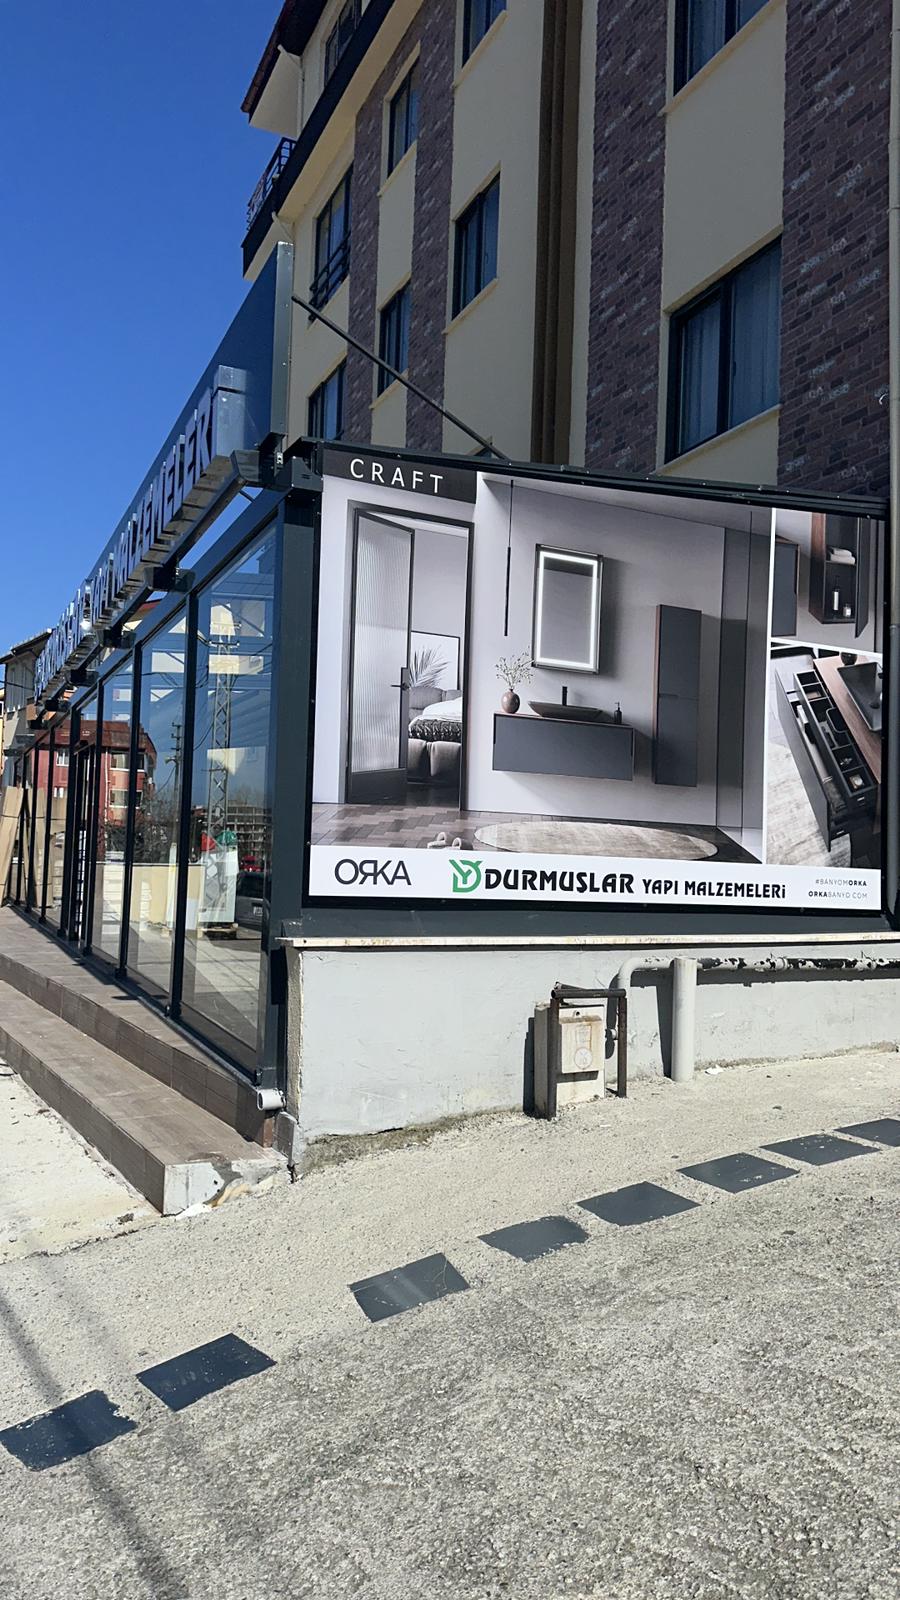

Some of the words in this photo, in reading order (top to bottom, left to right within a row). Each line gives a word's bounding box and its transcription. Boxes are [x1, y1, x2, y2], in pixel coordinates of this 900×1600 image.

[350, 458, 443, 493] CRAFT
[334, 858, 412, 886] ORKA
[642, 878, 679, 895] YAPI
